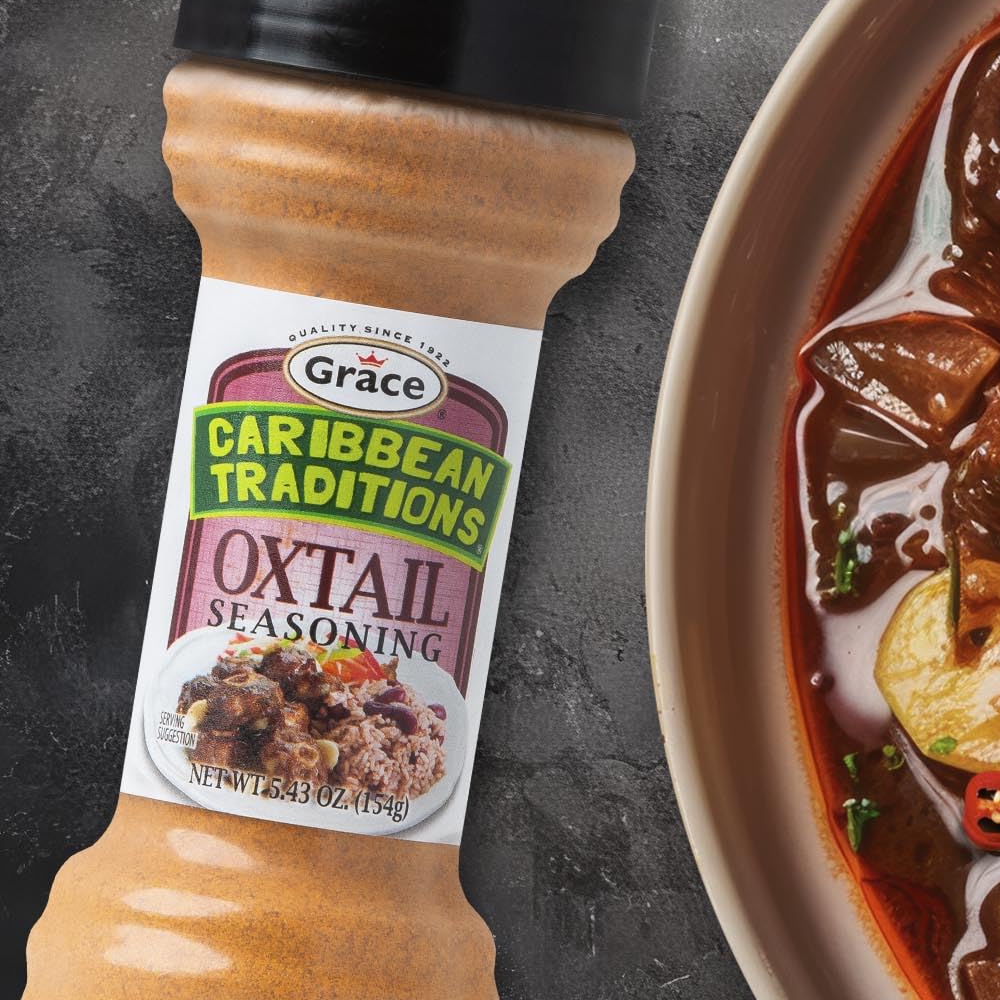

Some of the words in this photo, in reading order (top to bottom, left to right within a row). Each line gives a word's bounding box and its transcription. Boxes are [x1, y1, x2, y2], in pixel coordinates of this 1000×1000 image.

[288, 323, 357, 342] QUALITY
[364, 325, 413, 344] SINCE
[419, 341, 451, 368] 1922
[304, 355, 425, 400] Grace
[208, 414, 494, 500] CARIBBEAN
[209, 461, 486, 546] TRADITIONS
[212, 528, 449, 628] OXTAIL
[207, 598, 442, 663] SEASONING
[156, 726, 196, 747] SUGGESTION
[159, 711, 186, 729] SERVING
[189, 763, 228, 790] NET
[231, 771, 266, 797] WT
[269, 777, 310, 804] 5.43
[316, 785, 349, 811] OZ.
[354, 790, 409, 823] (154g)
